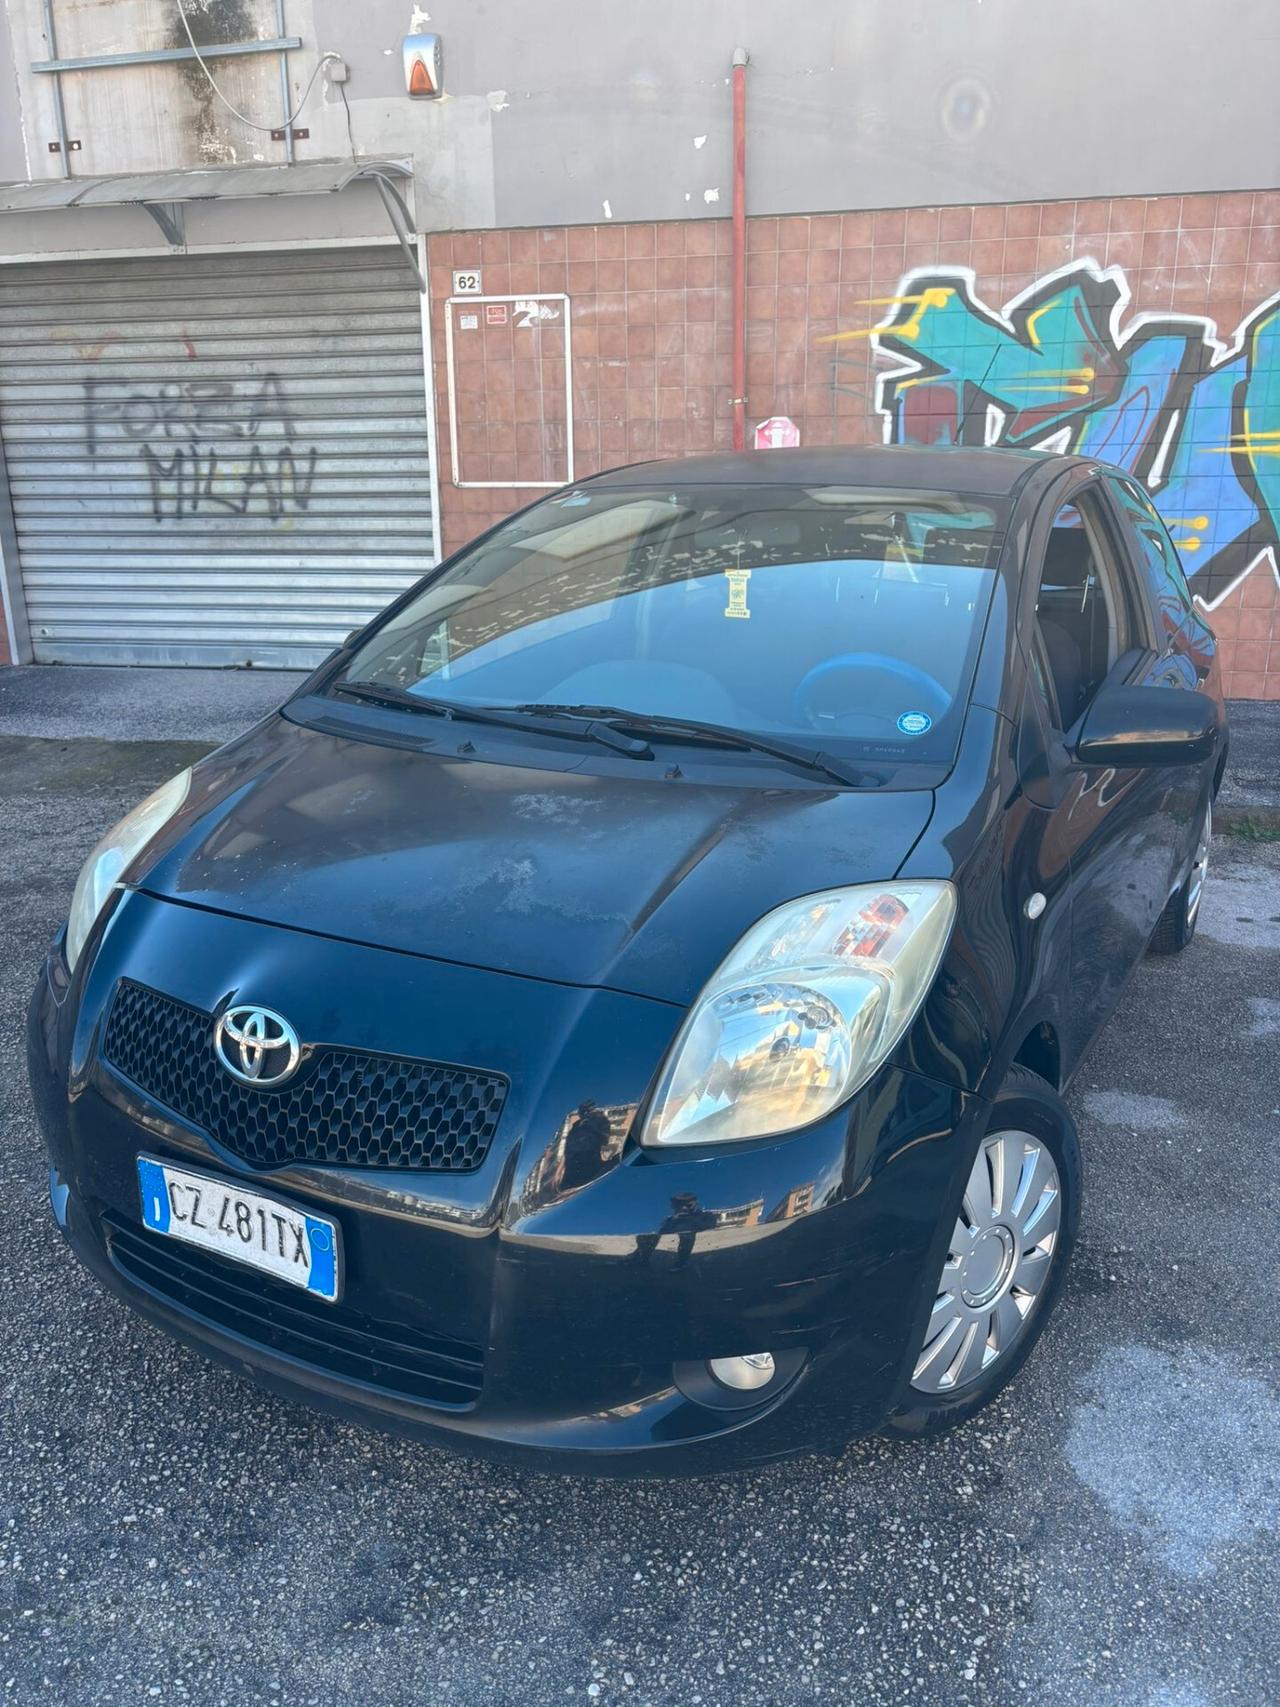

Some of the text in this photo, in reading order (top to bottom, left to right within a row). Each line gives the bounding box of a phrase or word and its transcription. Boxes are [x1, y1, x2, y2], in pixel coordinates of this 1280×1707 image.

[458, 275, 477, 290] 62
[138, 443, 318, 523] MILAN
[153, 1197, 161, 1222] I
[168, 1181, 309, 1269] CZ 481TX
